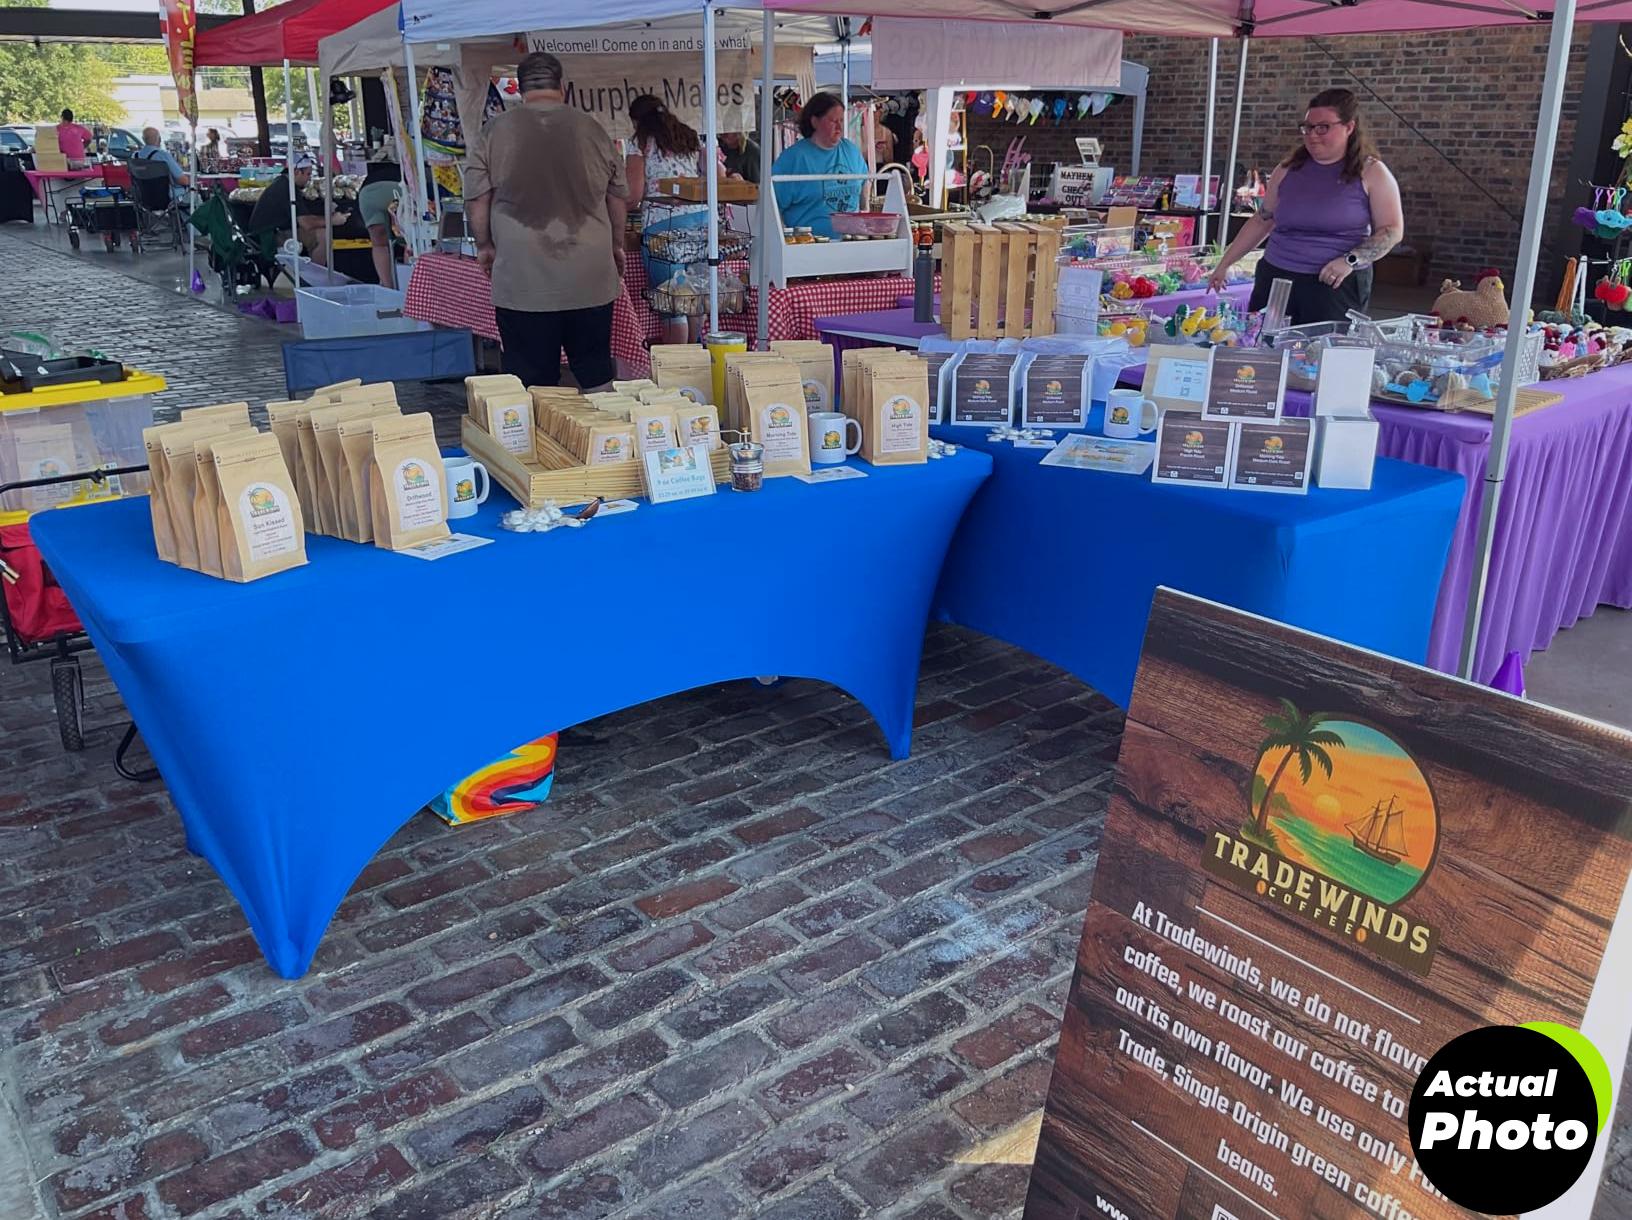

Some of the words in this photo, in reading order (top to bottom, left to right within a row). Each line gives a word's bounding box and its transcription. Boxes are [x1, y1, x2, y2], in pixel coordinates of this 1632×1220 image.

[533, 38, 598, 52] Welcome!!
[602, 38, 638, 52] Come
[641, 40, 656, 51] on
[660, 37, 669, 50] in
[672, 36, 693, 50] and
[719, 35, 747, 48] what
[662, 77, 745, 108] Maes
[1060, 171, 1094, 181] MAYHEM
[253, 522, 266, 530] Sun
[265, 517, 286, 527] Kissed
[406, 491, 433, 502] Driftwood
[1213, 831, 1430, 954] TRADEWINDS
[1268, 886, 1354, 935] COFFEE
[1131, 901, 1154, 929] At
[1156, 911, 1265, 993] Tradewinds,
[1270, 976, 1301, 1008] we
[1304, 993, 1331, 1024] do
[1334, 1011, 1372, 1047] not
[1123, 945, 1184, 996] coffee,
[1188, 980, 1217, 1010] we
[1219, 999, 1271, 1041] roast
[1272, 1029, 1309, 1062] our
[1310, 1050, 1379, 1103] coffee
[1381, 1088, 1406, 1119] to
[1115, 986, 1146, 1017] out
[1146, 1000, 1171, 1032] its
[1172, 1020, 1213, 1057] own
[1214, 1041, 1275, 1095] flavor.
[1280, 1078, 1314, 1117] We
[1316, 1105, 1356, 1142] use
[1358, 1131, 1407, 1175] only
[1118, 1028, 1169, 1081] Trade,
[1173, 1064, 1230, 1115] Single
[1232, 1101, 1290, 1153] Origin
[1291, 1142, 1352, 1193] green
[1354, 1182, 1420, 1220] coffe
[1216, 1138, 1279, 1197] beans.
